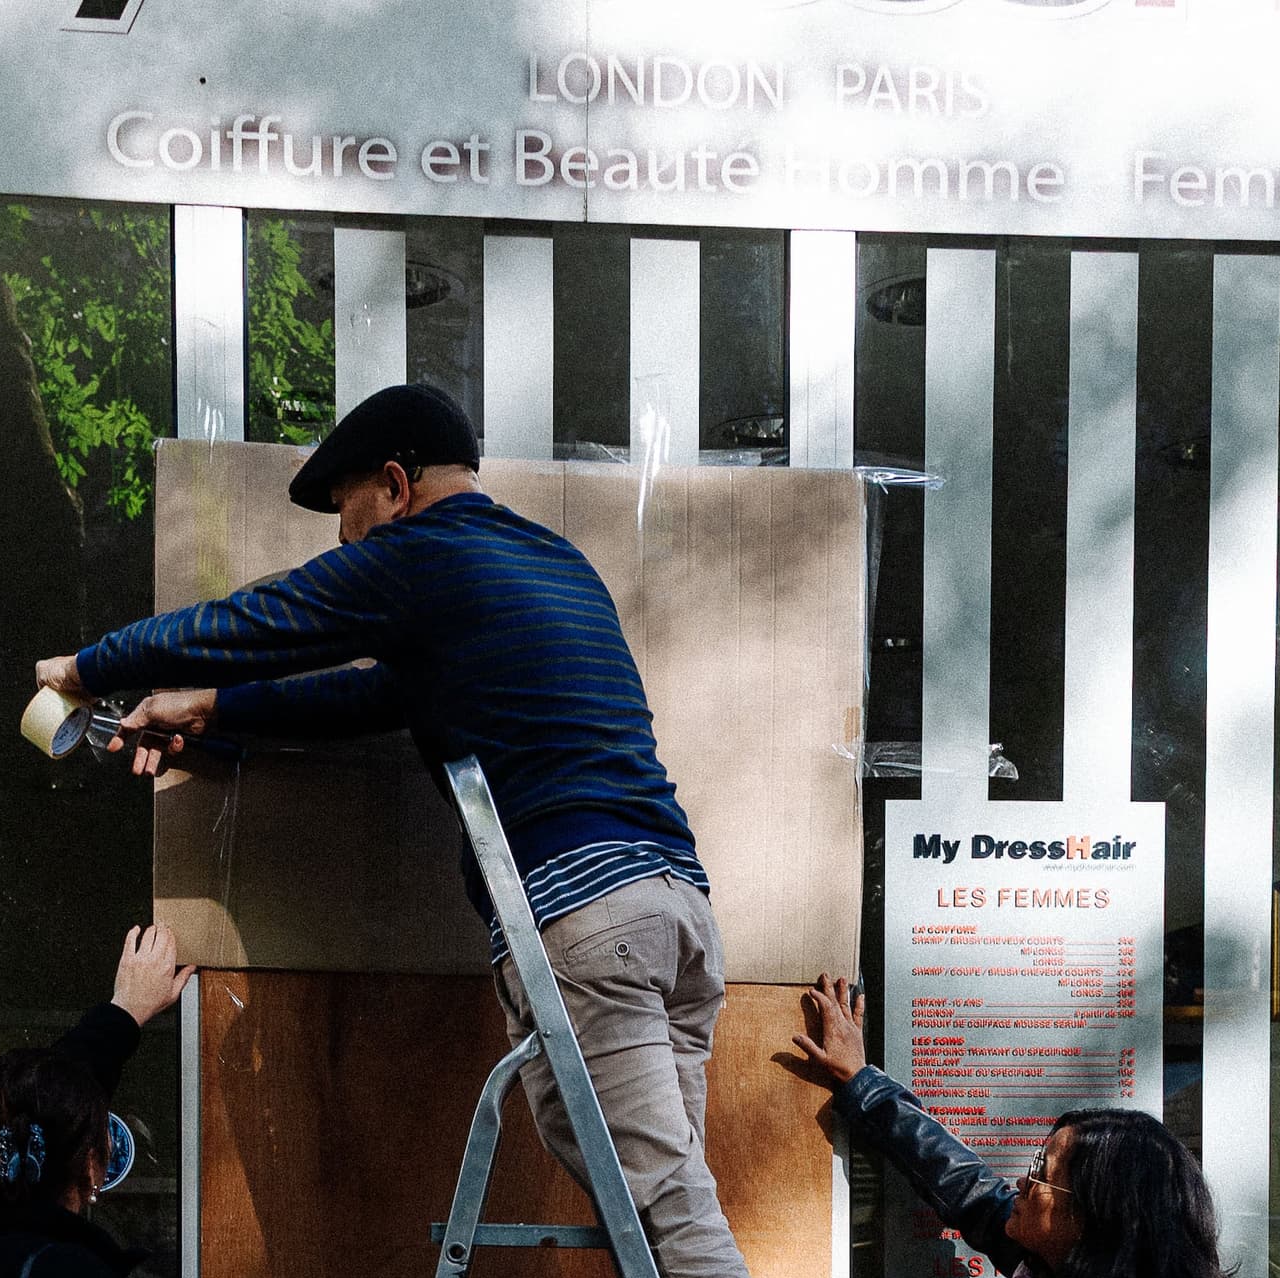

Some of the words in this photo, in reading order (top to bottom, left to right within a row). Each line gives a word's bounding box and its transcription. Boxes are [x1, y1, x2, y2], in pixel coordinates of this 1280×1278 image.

[527, 52, 785, 110] LONDON
[835, 62, 992, 120] PARIS
[105, 110, 399, 180] Coiffure
[420, 136, 491, 185] et
[513, 129, 760, 195] Beauté
[787, 149, 1065, 203] Homme
[912, 833, 961, 865] My
[971, 834, 1137, 861] DressHair
[937, 887, 988, 909] LES
[997, 887, 1111, 909] FEMMES
